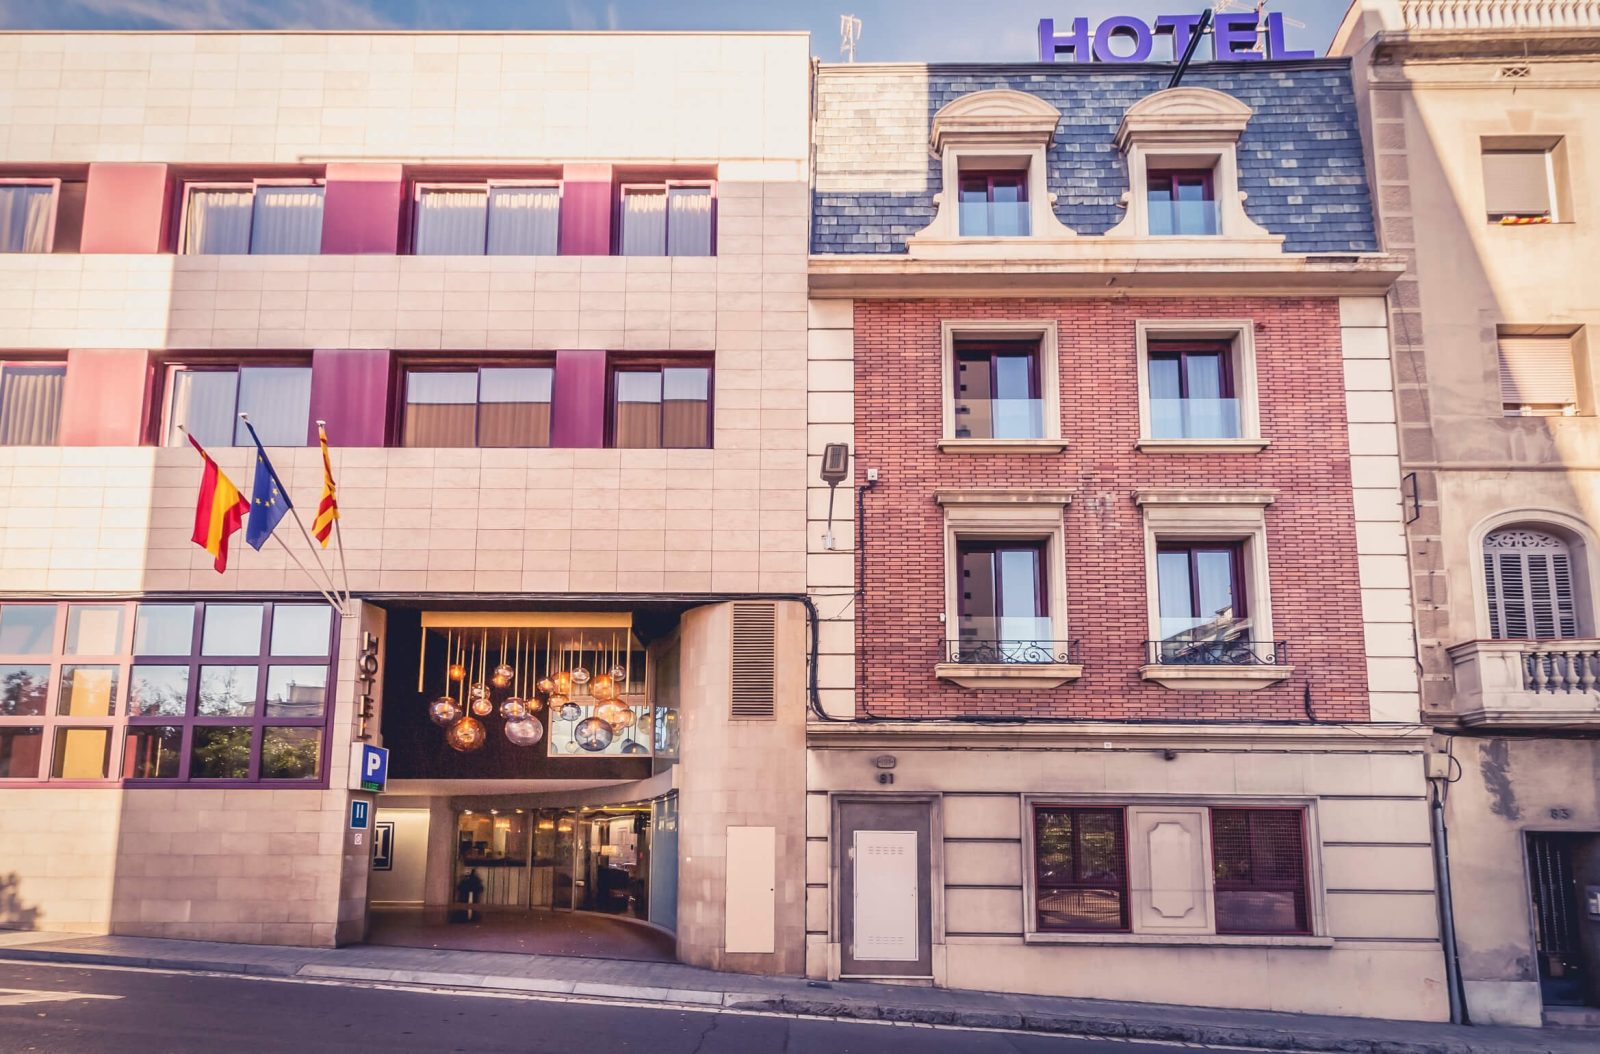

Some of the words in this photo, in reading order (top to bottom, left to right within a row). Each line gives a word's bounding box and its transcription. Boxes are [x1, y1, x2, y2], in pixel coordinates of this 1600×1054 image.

[1038, 12, 1315, 62] HOTEL
[357, 631, 379, 740] HOTEL
[367, 752, 381, 776] P
